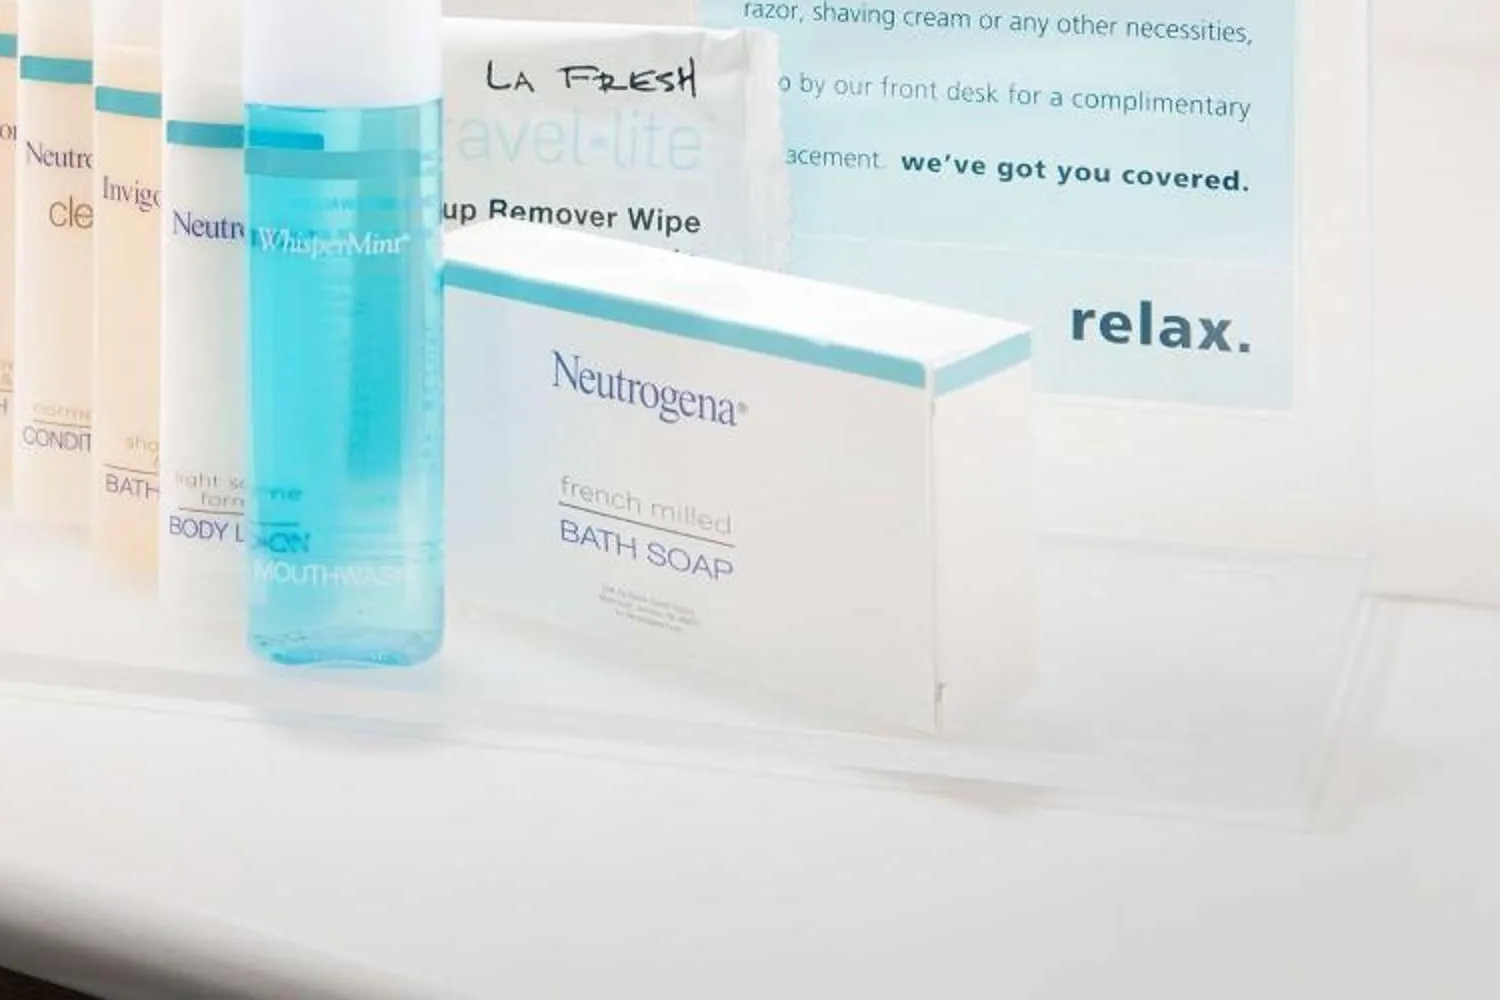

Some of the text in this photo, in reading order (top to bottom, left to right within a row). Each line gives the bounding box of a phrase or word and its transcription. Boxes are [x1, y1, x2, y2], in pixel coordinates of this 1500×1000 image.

[743, 0, 1253, 46] razor, shaving cream or any other necessities,
[557, 55, 698, 98] FRESH
[777, 72, 1252, 123] o by our front desk for a complimentary
[901, 153, 987, 176] we've
[997, 159, 1047, 183] got
[1056, 164, 1111, 186] you
[1121, 168, 1250, 192] covered.
[488, 198, 619, 229] Remover
[627, 207, 701, 238] Wipe
[1071, 299, 1251, 354] relax.
[168, 515, 229, 541] BODY
[560, 475, 733, 536] french milled
[560, 518, 735, 582] BATH SOAP
